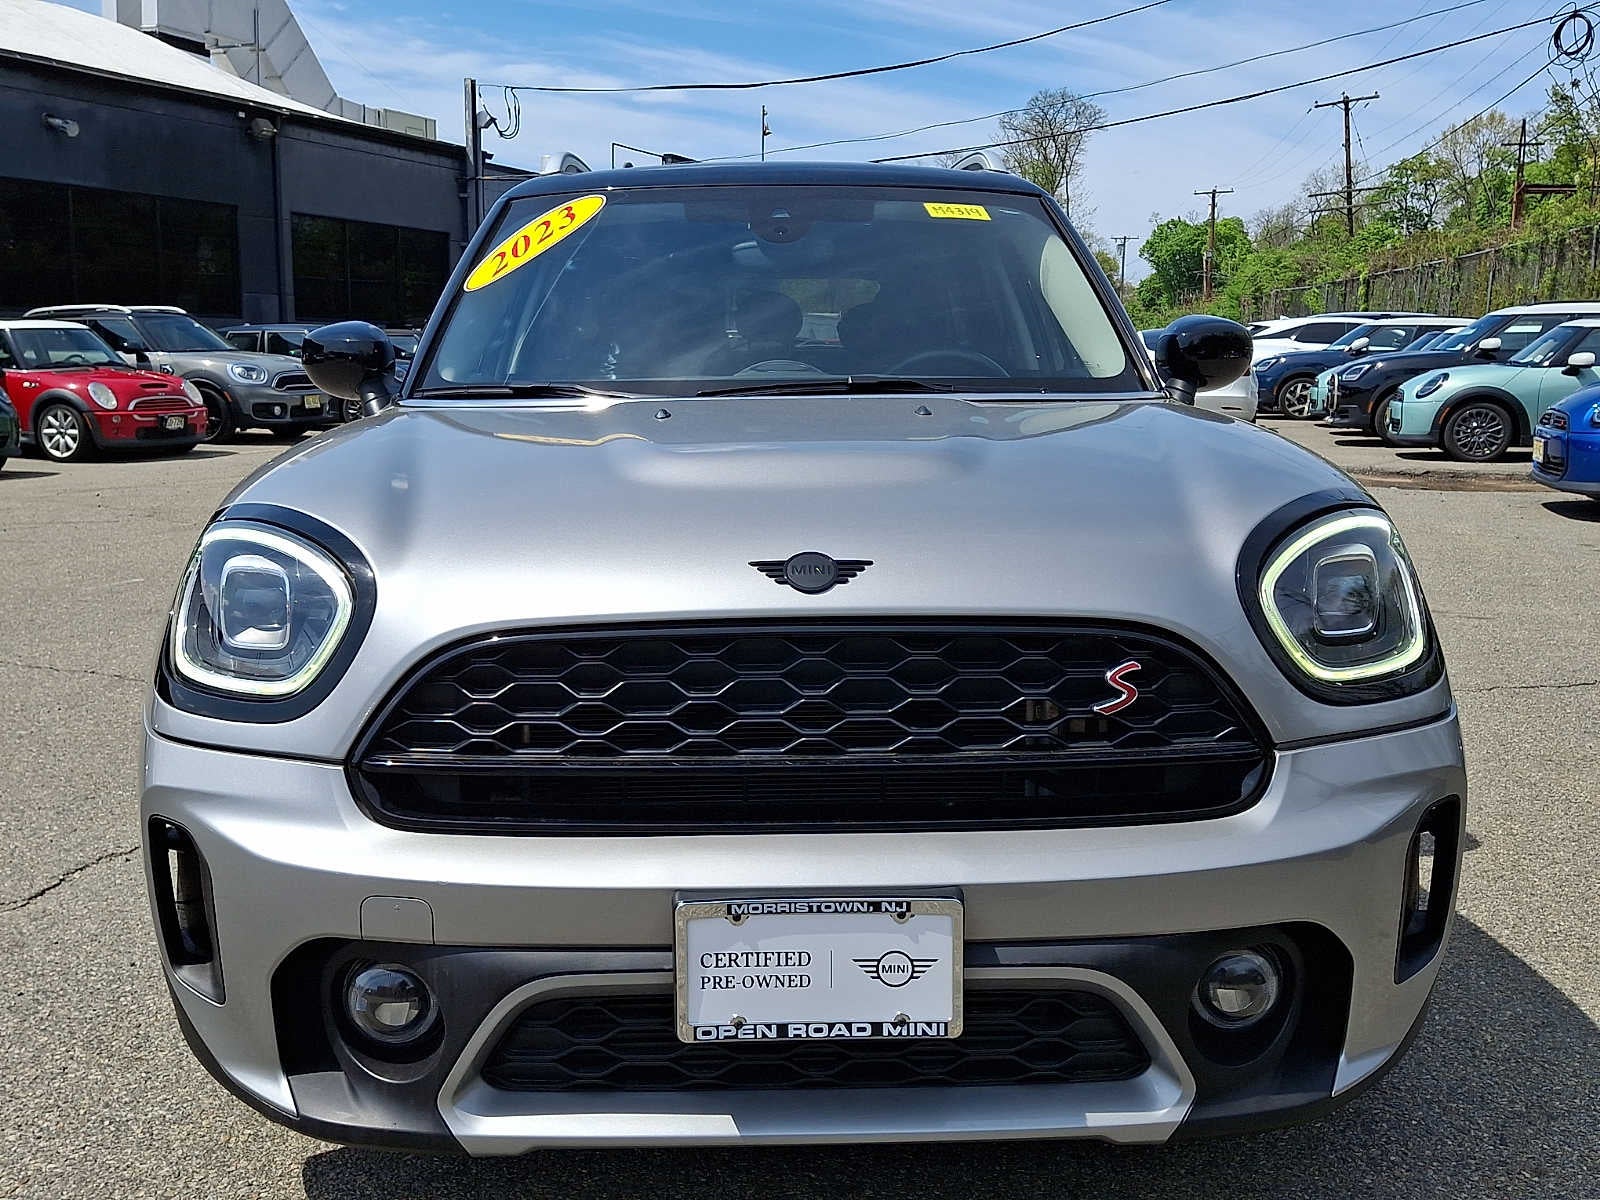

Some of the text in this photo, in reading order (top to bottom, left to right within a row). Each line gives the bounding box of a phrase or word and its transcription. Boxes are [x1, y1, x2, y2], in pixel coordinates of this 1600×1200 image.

[491, 206, 576, 278] 2023
[791, 564, 831, 576] MINI
[1093, 661, 1141, 715] S
[731, 902, 907, 915] MORRISTOWN, NJ
[700, 951, 812, 969] CERTIFIED
[881, 964, 910, 974] MINI
[700, 974, 812, 990] PRE-OWNED
[696, 1022, 946, 1040] OPEN ROAD MINI
